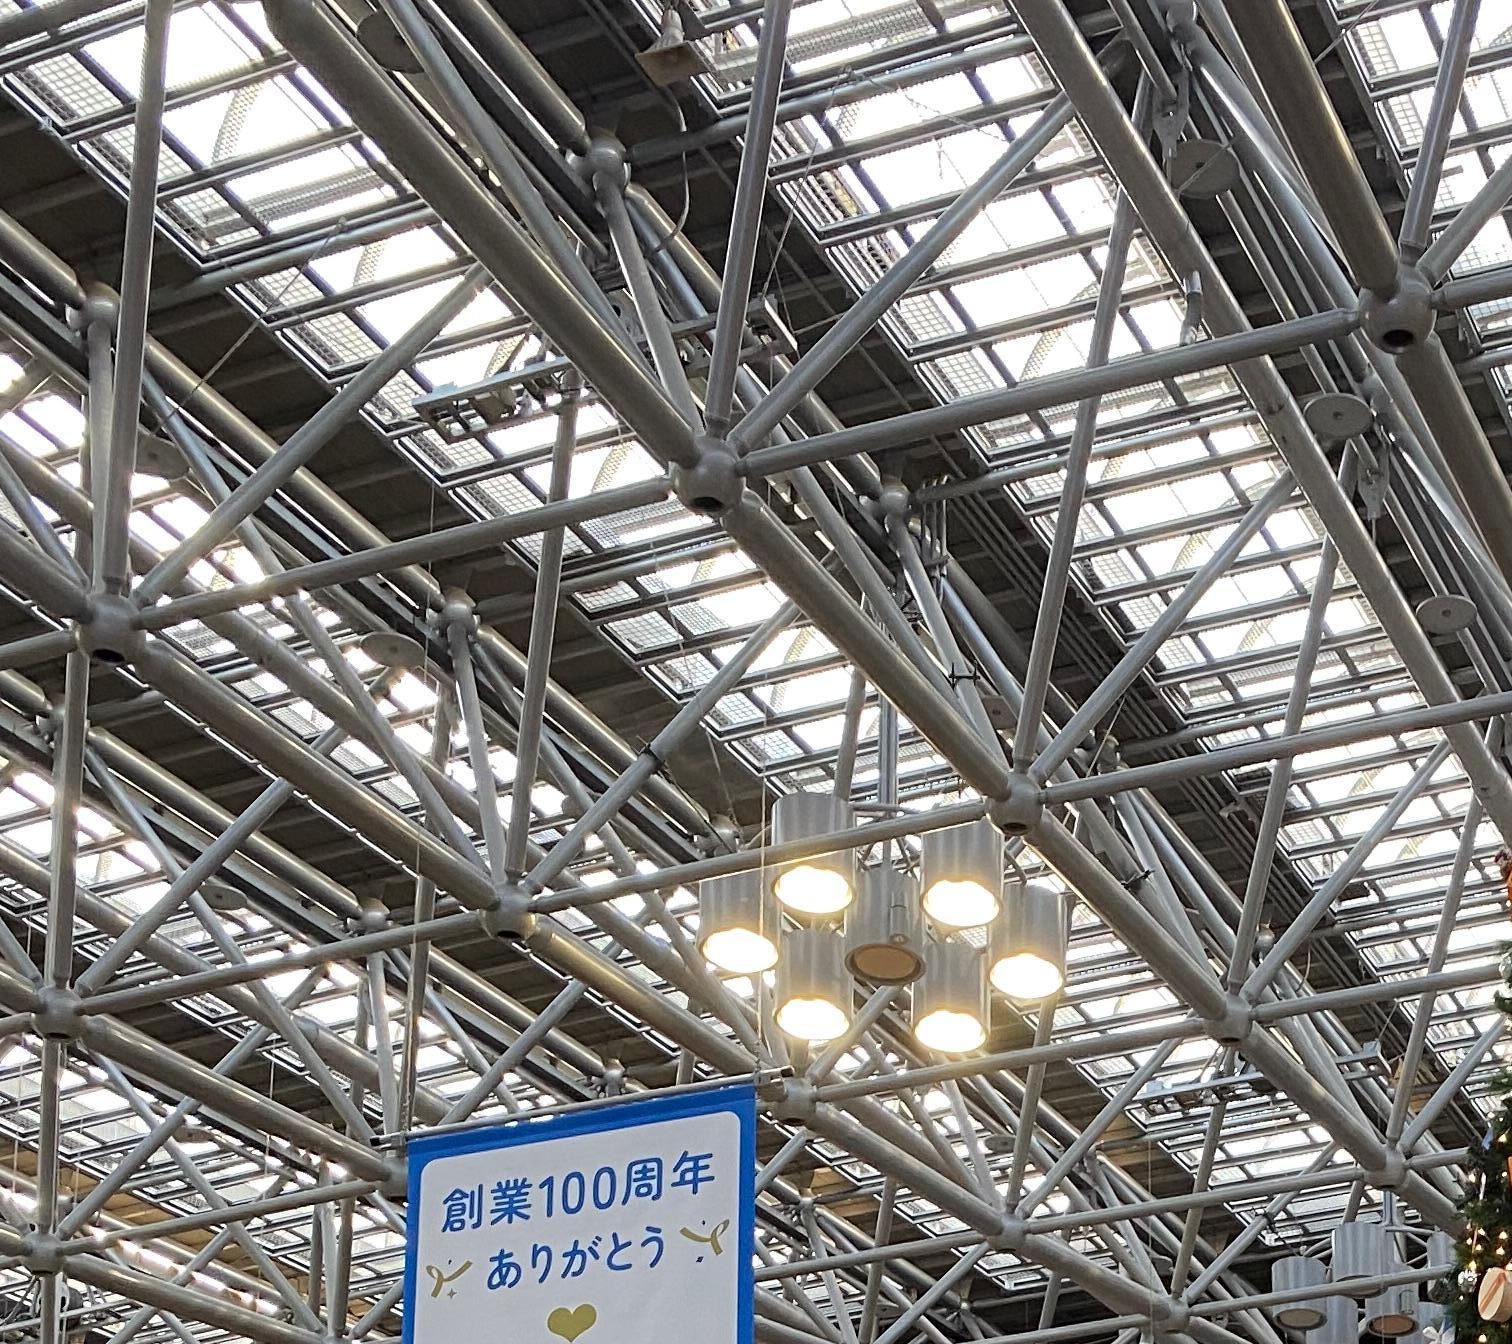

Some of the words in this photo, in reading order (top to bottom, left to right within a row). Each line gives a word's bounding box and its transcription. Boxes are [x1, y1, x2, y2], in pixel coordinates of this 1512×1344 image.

[441, 1150, 716, 1233] 創業100周年
[486, 1225, 666, 1291] ありがとう
